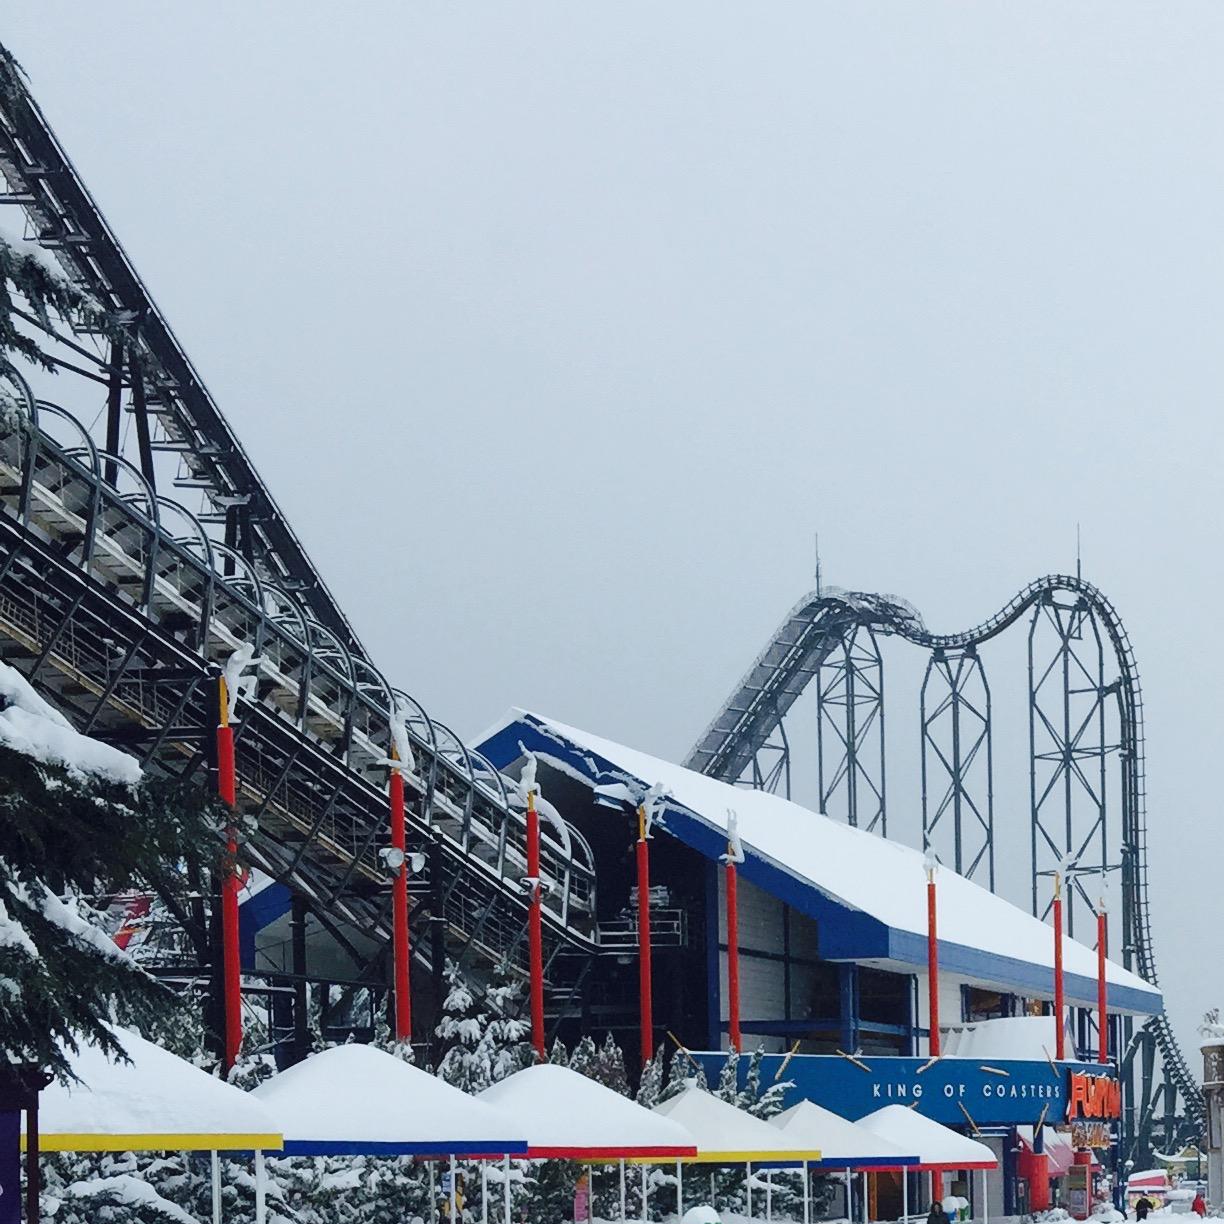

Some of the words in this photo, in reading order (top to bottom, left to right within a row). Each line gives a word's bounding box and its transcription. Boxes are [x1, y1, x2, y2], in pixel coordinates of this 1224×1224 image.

[873, 1083, 923, 1098] KING
[944, 1083, 966, 1098] OF
[983, 1084, 1061, 1099] COASTERS
